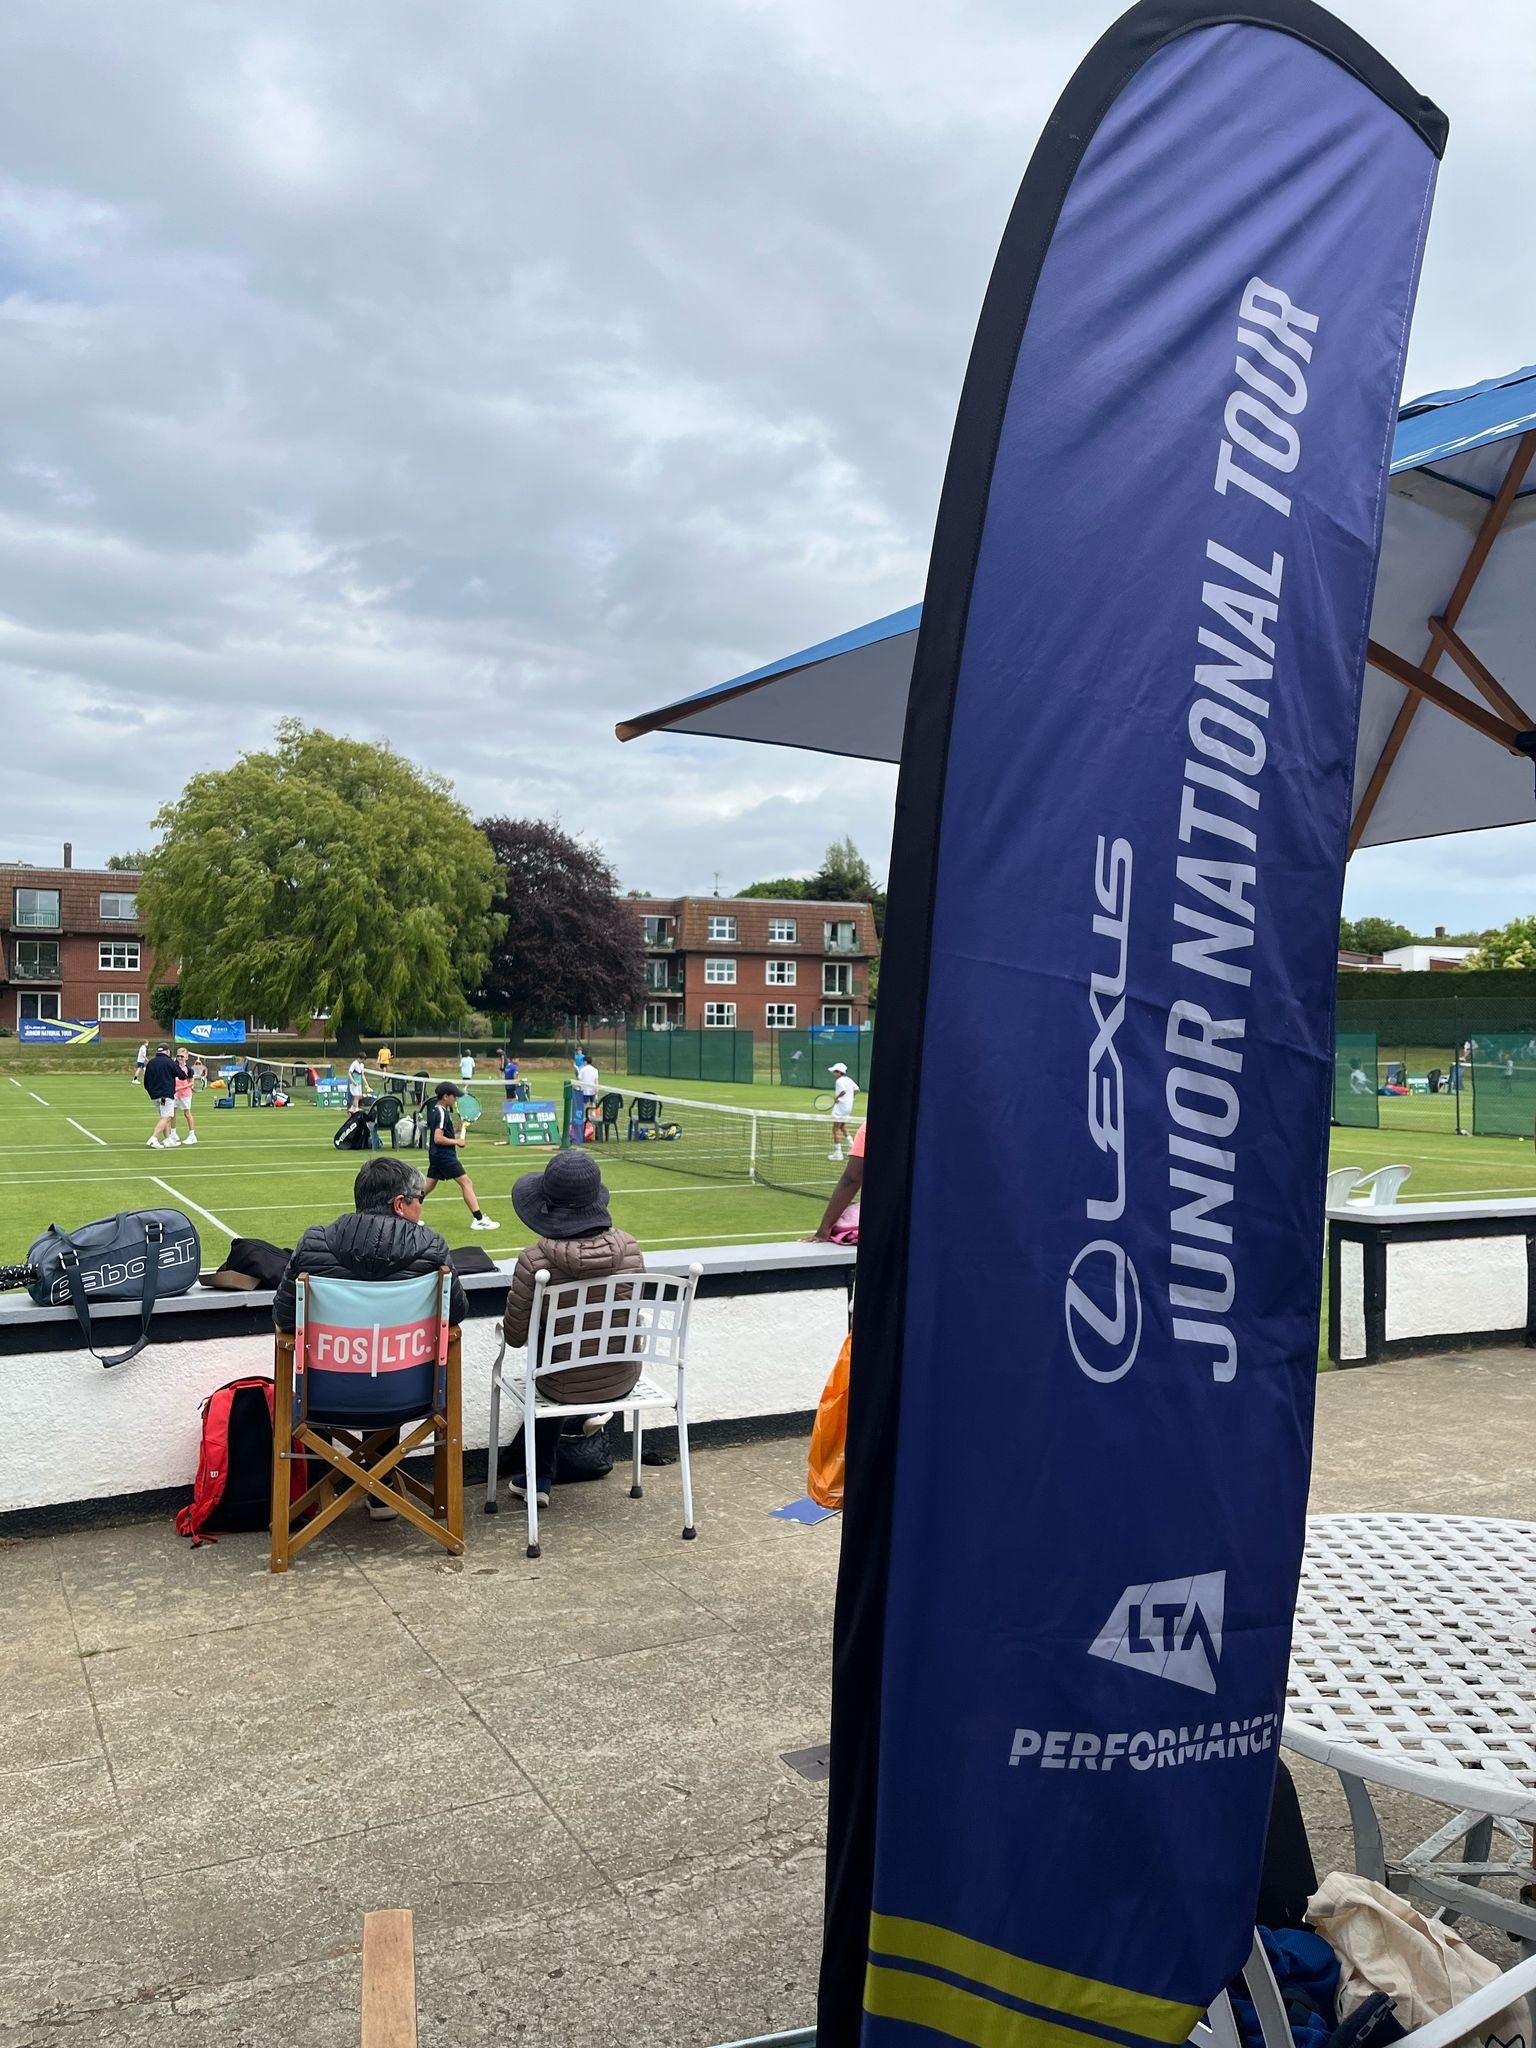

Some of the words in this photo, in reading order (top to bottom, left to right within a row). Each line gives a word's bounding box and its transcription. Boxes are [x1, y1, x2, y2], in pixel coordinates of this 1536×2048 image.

[1214, 276, 1320, 518] TOUR
[1171, 539, 1285, 988] NATIONAL
[335, 1122, 358, 1146] HEAD
[518, 1134, 526, 1143] 2
[1086, 834, 1134, 1222] LEXUS
[1165, 999, 1247, 1383] JUNIOR
[1007, 1712, 1275, 1772] PERFORMANCE
